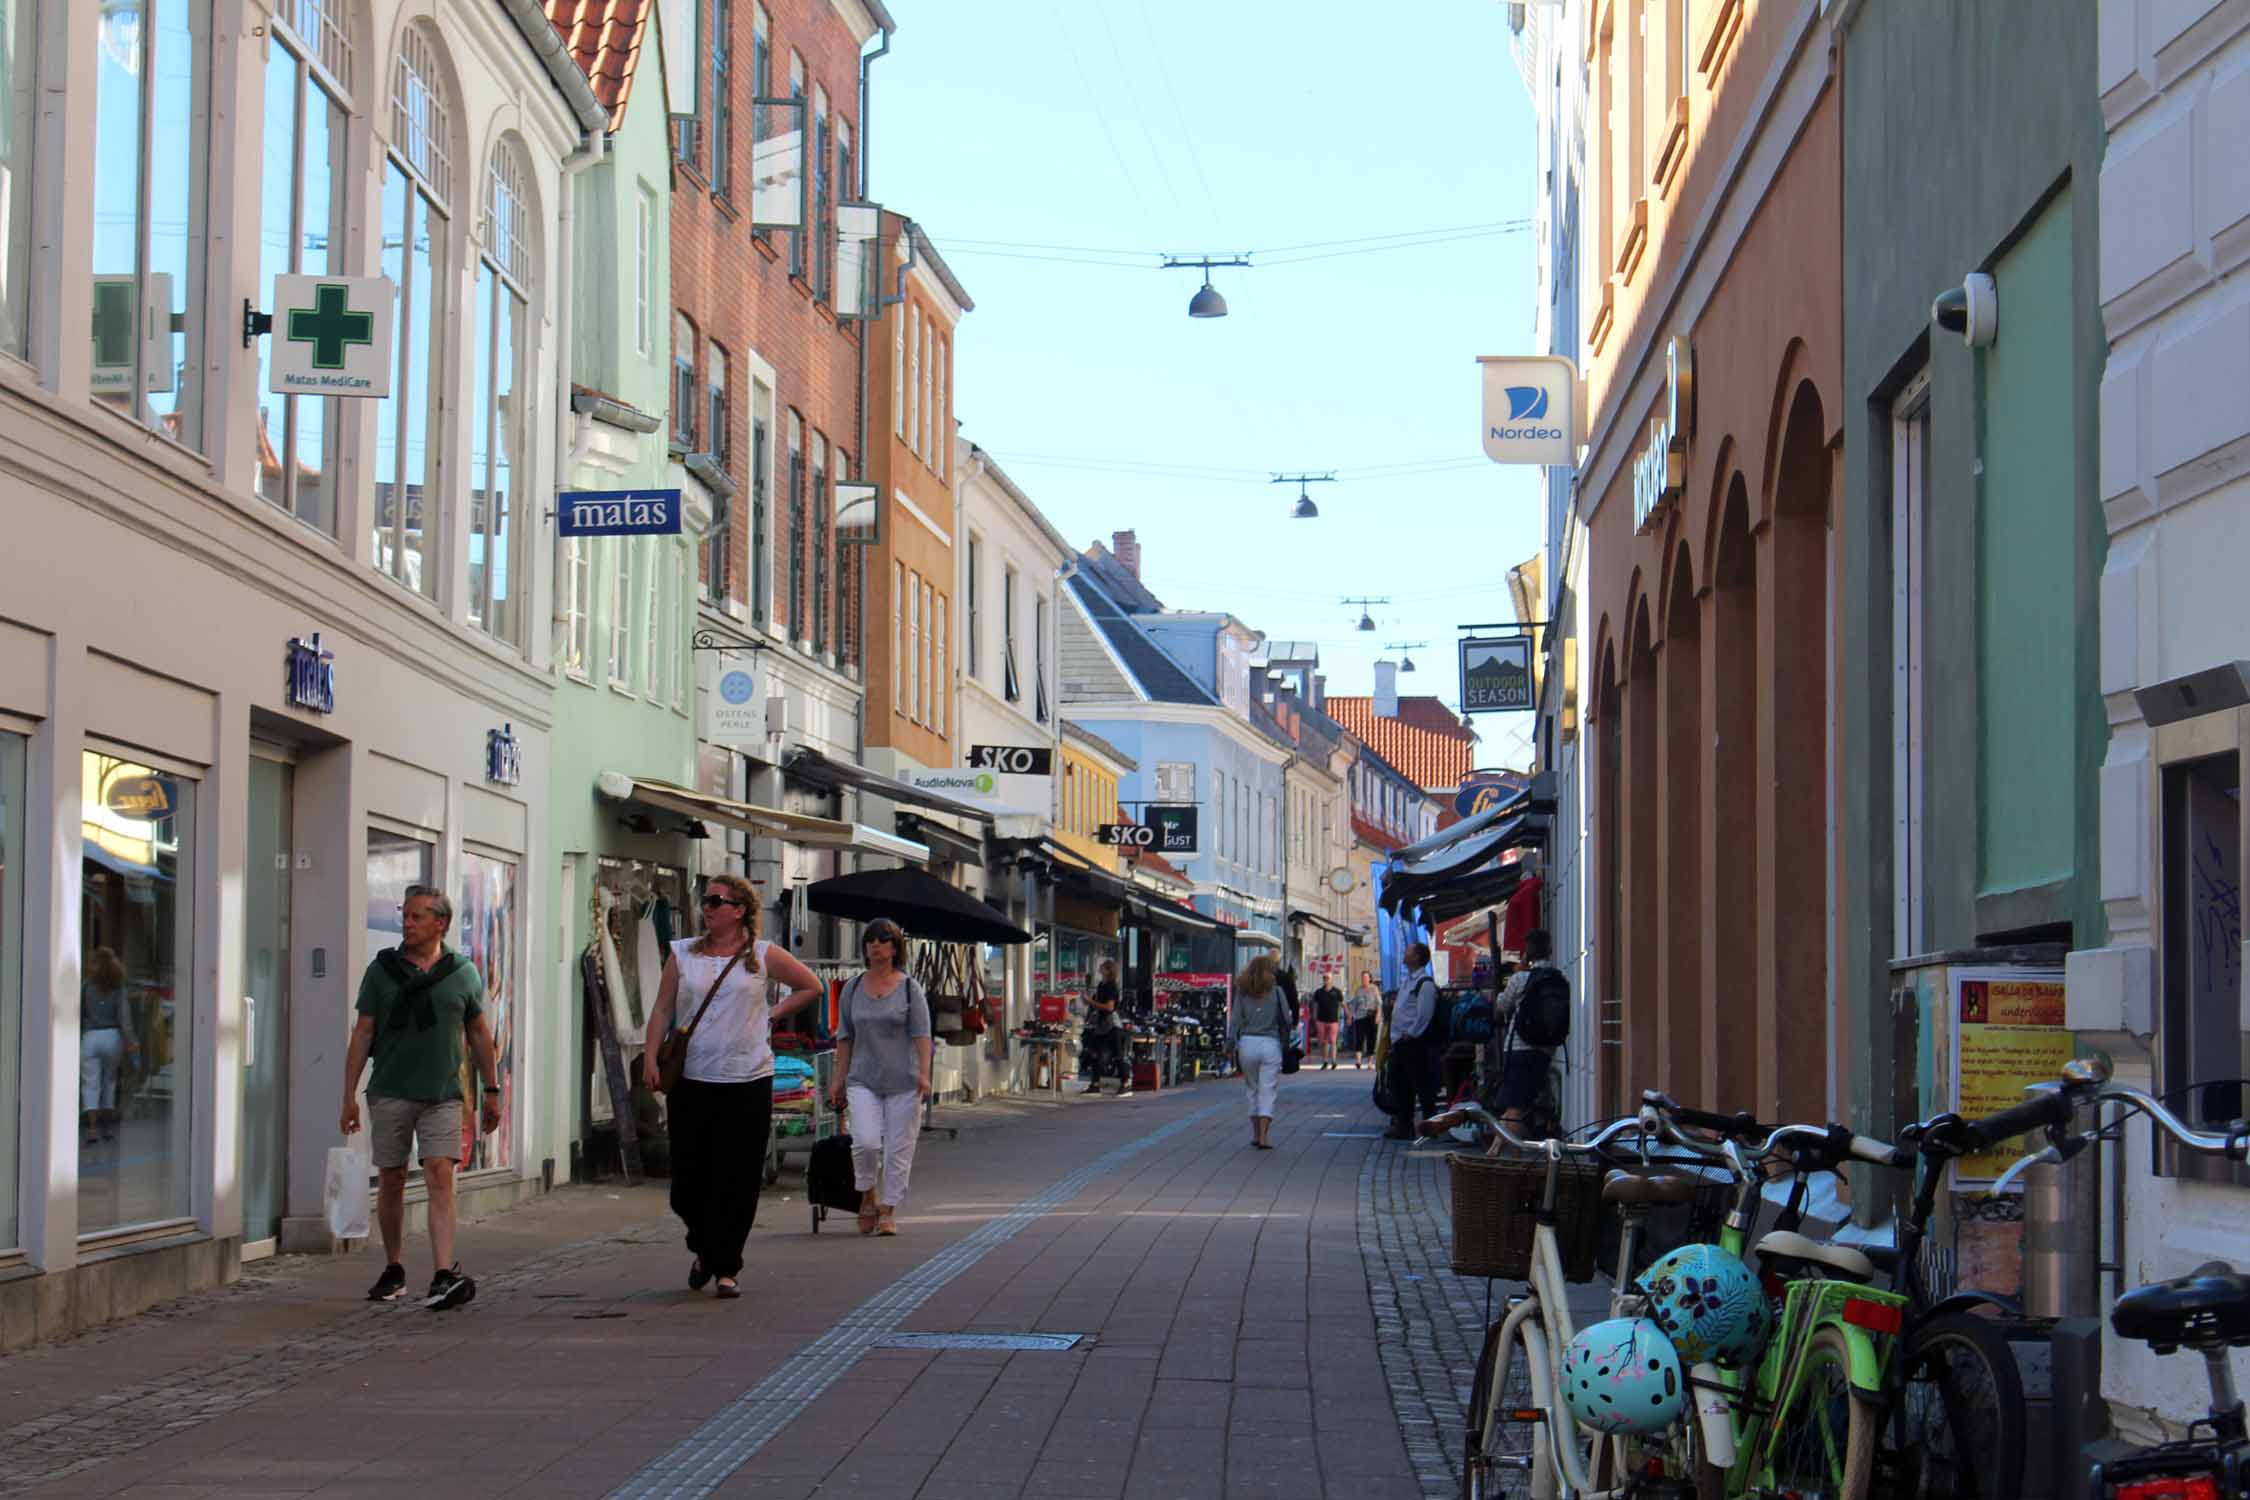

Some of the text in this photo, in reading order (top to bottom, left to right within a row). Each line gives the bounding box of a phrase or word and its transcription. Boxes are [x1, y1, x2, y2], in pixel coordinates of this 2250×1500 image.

[285, 374, 371, 388] Matas MediCare
[1491, 426, 1563, 440] Nordea
[572, 494, 668, 527] matas
[1468, 674, 1525, 689] OUTDOOR
[1468, 687, 1527, 704] SEASON
[979, 747, 1033, 772] SKO
[914, 777, 976, 789] AudioNova
[1109, 826, 1154, 846] SKO
